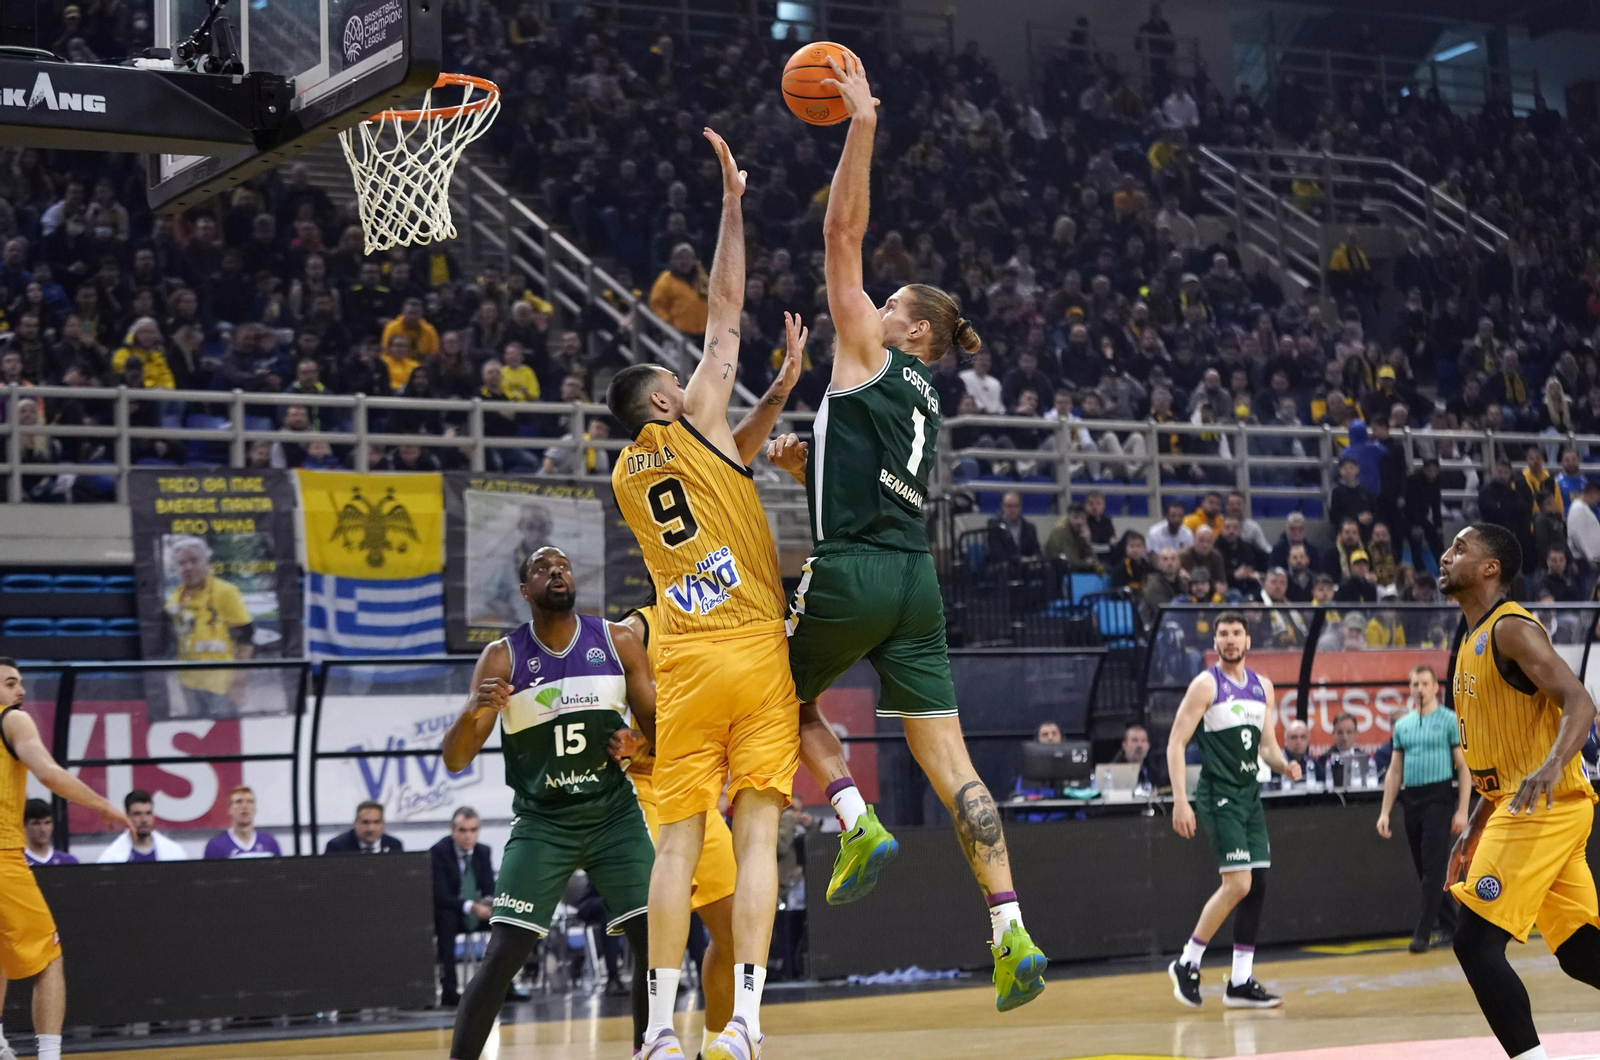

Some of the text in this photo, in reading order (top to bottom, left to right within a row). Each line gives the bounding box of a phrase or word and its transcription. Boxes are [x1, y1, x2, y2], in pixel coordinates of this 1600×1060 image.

[364, 29, 387, 49] LEAGUE
[0, 71, 106, 113] KANG
[906, 406, 926, 477] 1
[627, 446, 676, 476] ORIOA
[645, 474, 701, 550] 9
[697, 547, 729, 574] Juice
[669, 560, 737, 611] Viva
[701, 588, 731, 613] fresh
[561, 692, 599, 705] Unicaja
[554, 723, 587, 757] 15
[545, 768, 599, 789] Andalucía
